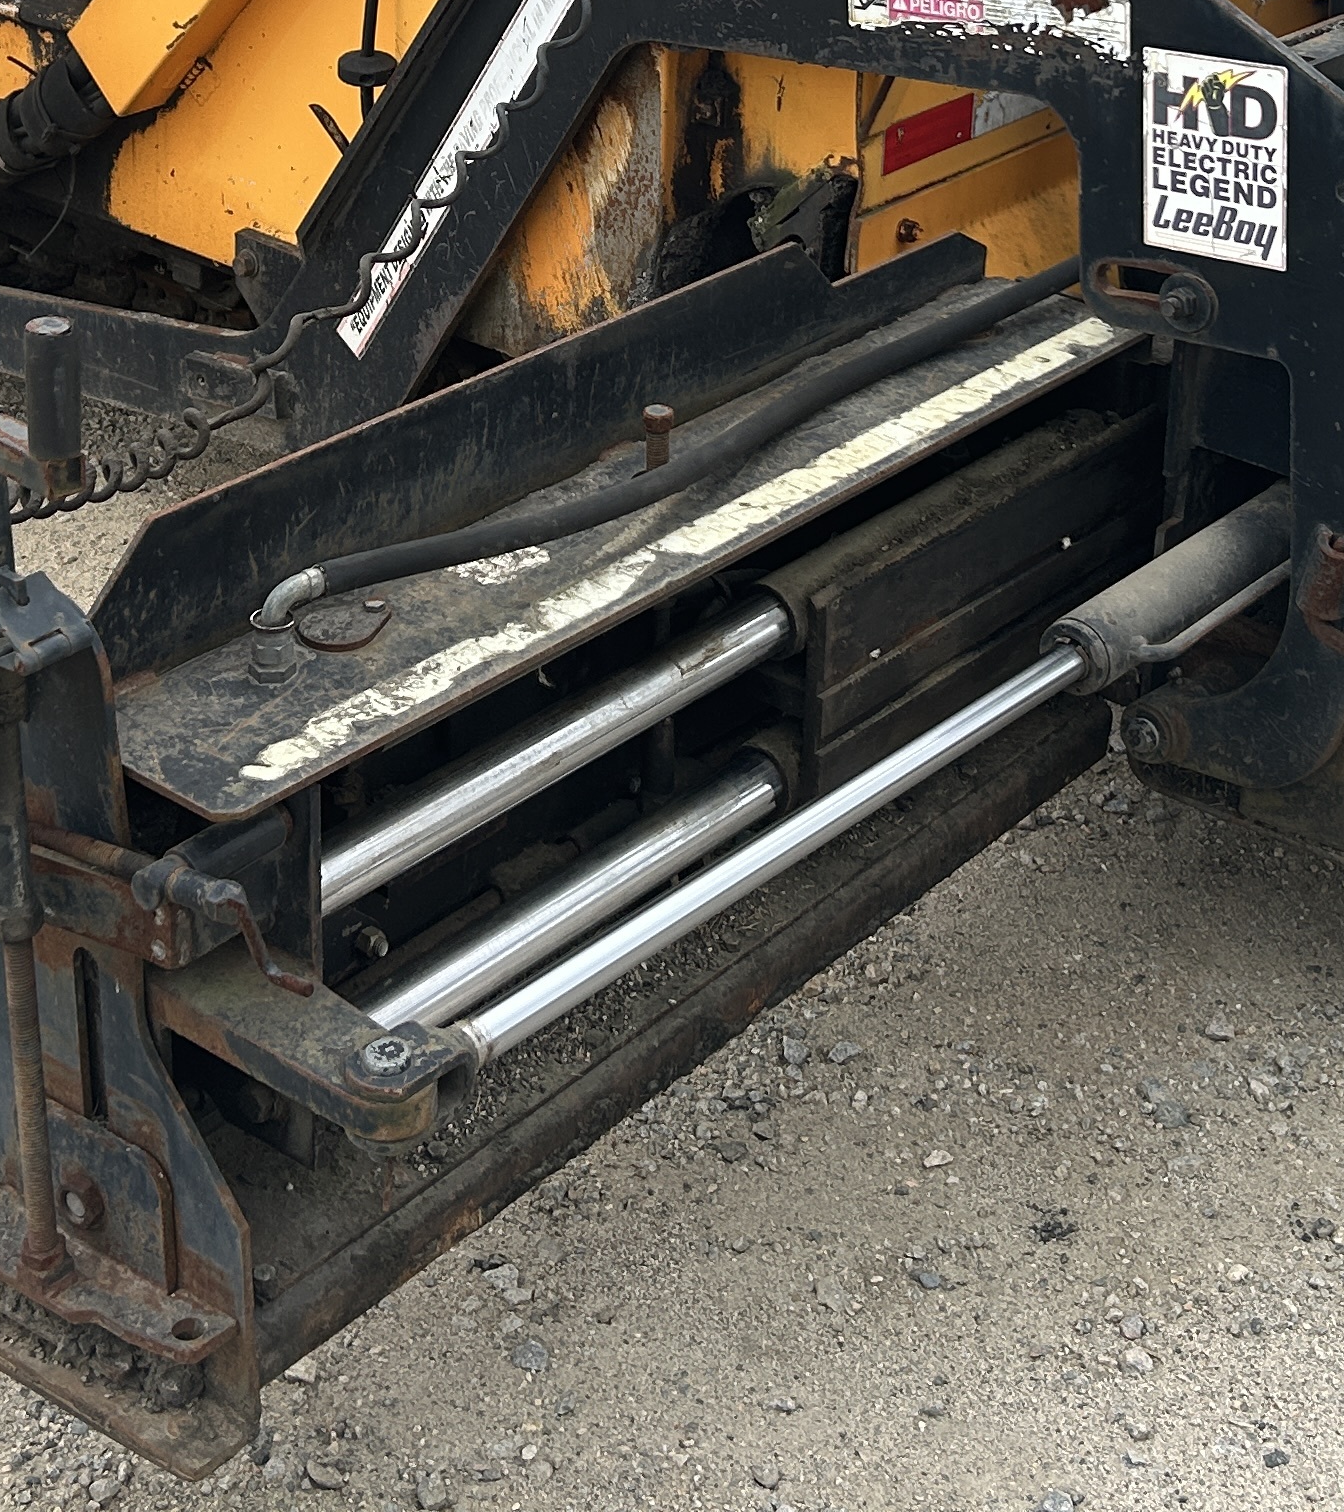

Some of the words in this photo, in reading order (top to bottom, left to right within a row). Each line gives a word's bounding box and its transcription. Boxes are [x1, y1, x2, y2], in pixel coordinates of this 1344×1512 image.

[1152, 128, 1218, 153] HEAVY
[1221, 140, 1277, 163] DUTY
[1152, 145, 1278, 185] ELECTRIC
[1152, 166, 1277, 209] LEGEND
[1152, 194, 1278, 262] LeeBoy
